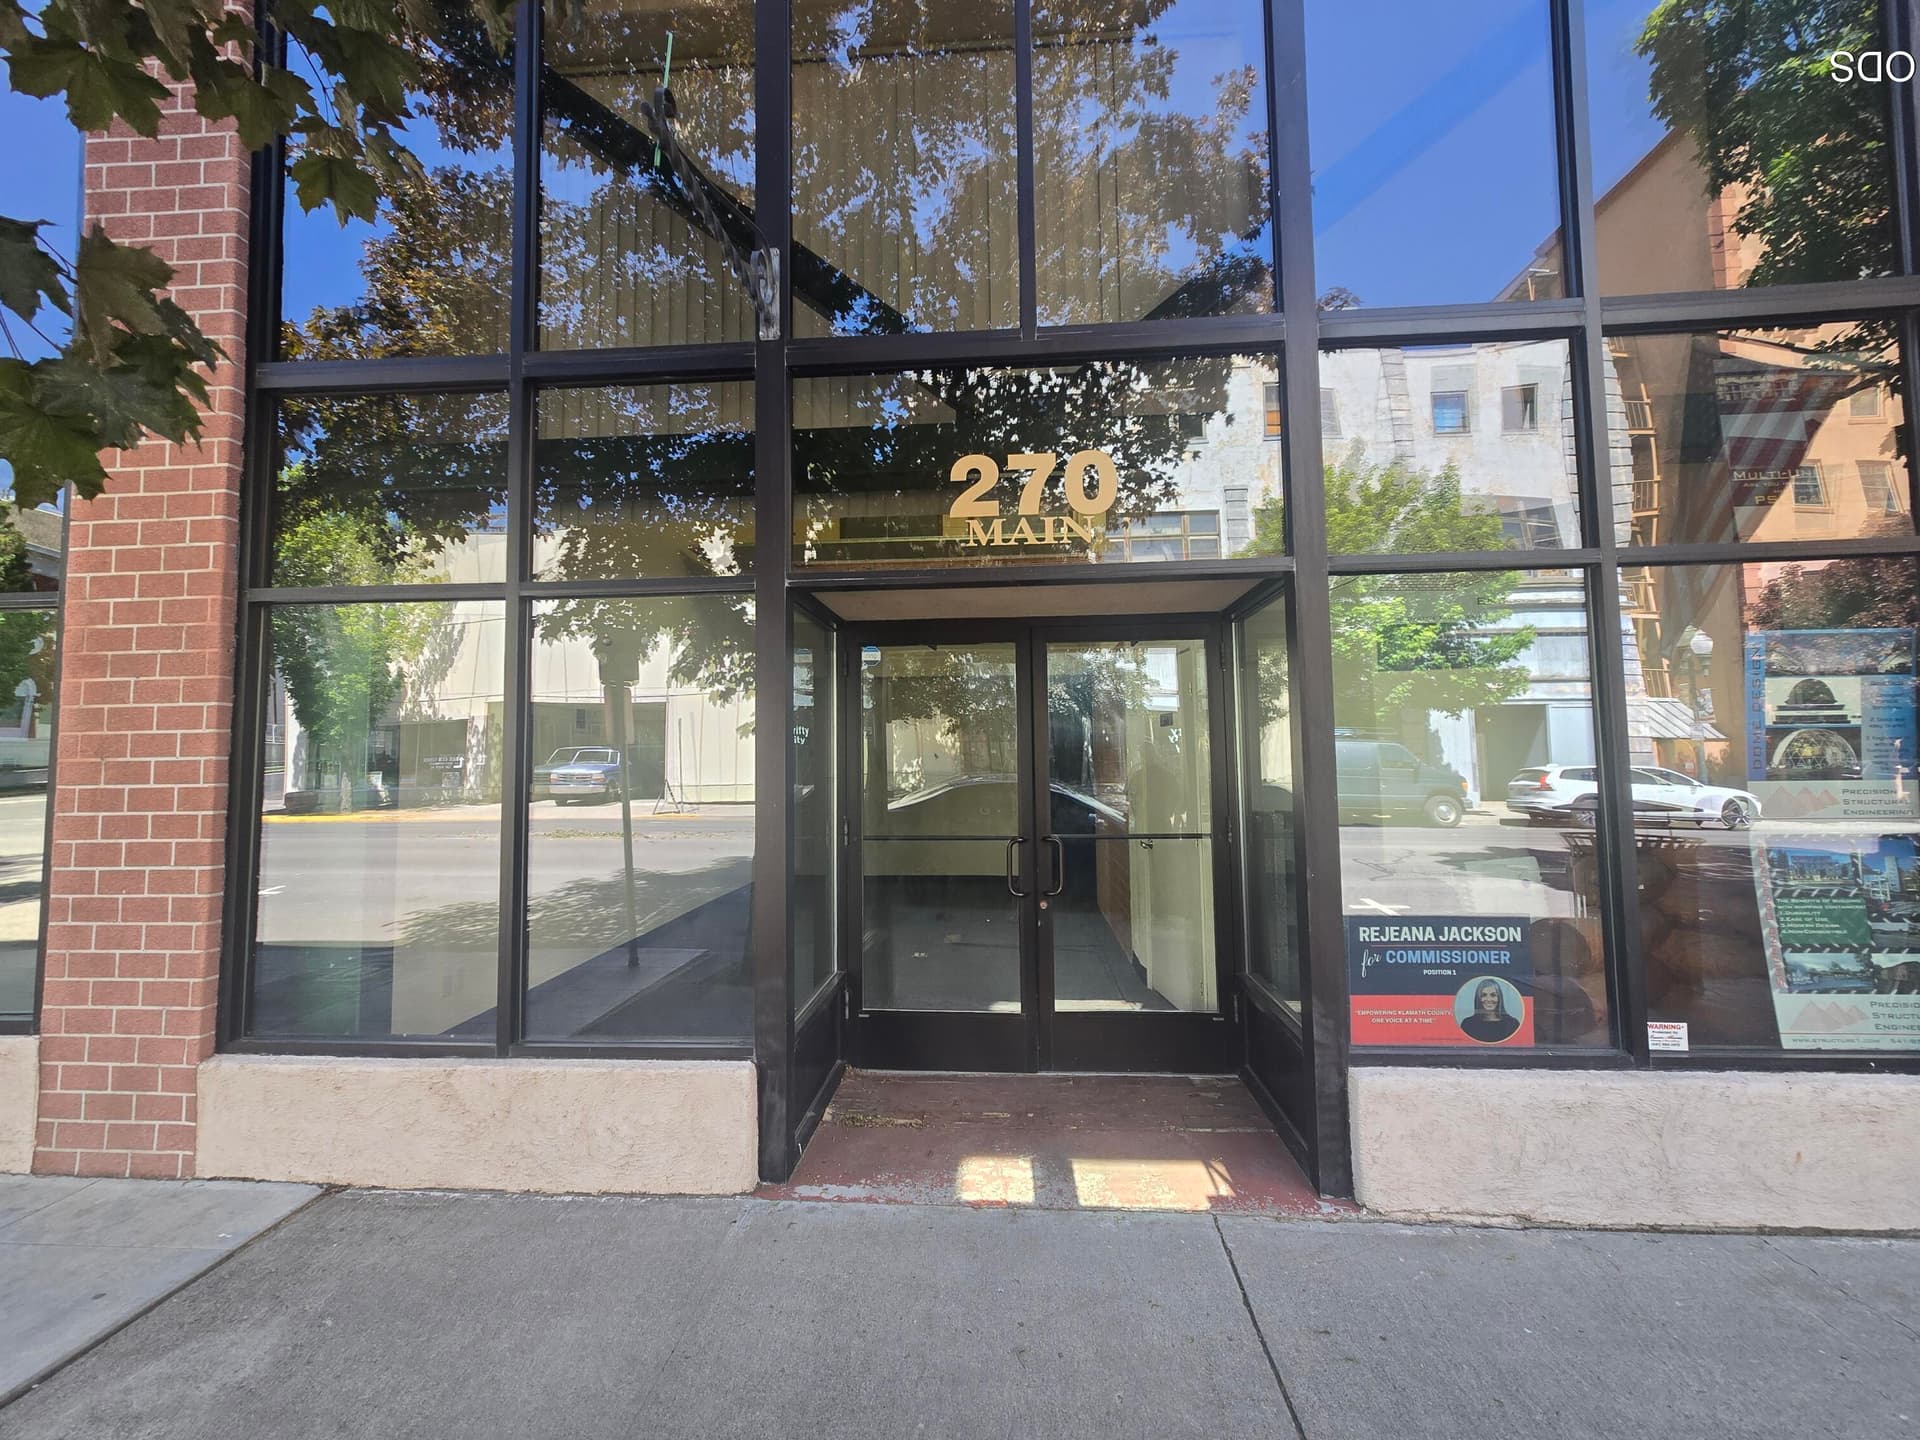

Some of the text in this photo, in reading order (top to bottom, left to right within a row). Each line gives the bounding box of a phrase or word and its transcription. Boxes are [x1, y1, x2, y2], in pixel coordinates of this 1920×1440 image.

[949, 449, 1118, 518] 270
[961, 515, 1095, 547] MAIN
[1751, 645, 1762, 770] DOME DESIGN
[1359, 926, 1522, 942] REJEANA JACKSON
[1360, 949, 1511, 978] for COMMISSIONER
